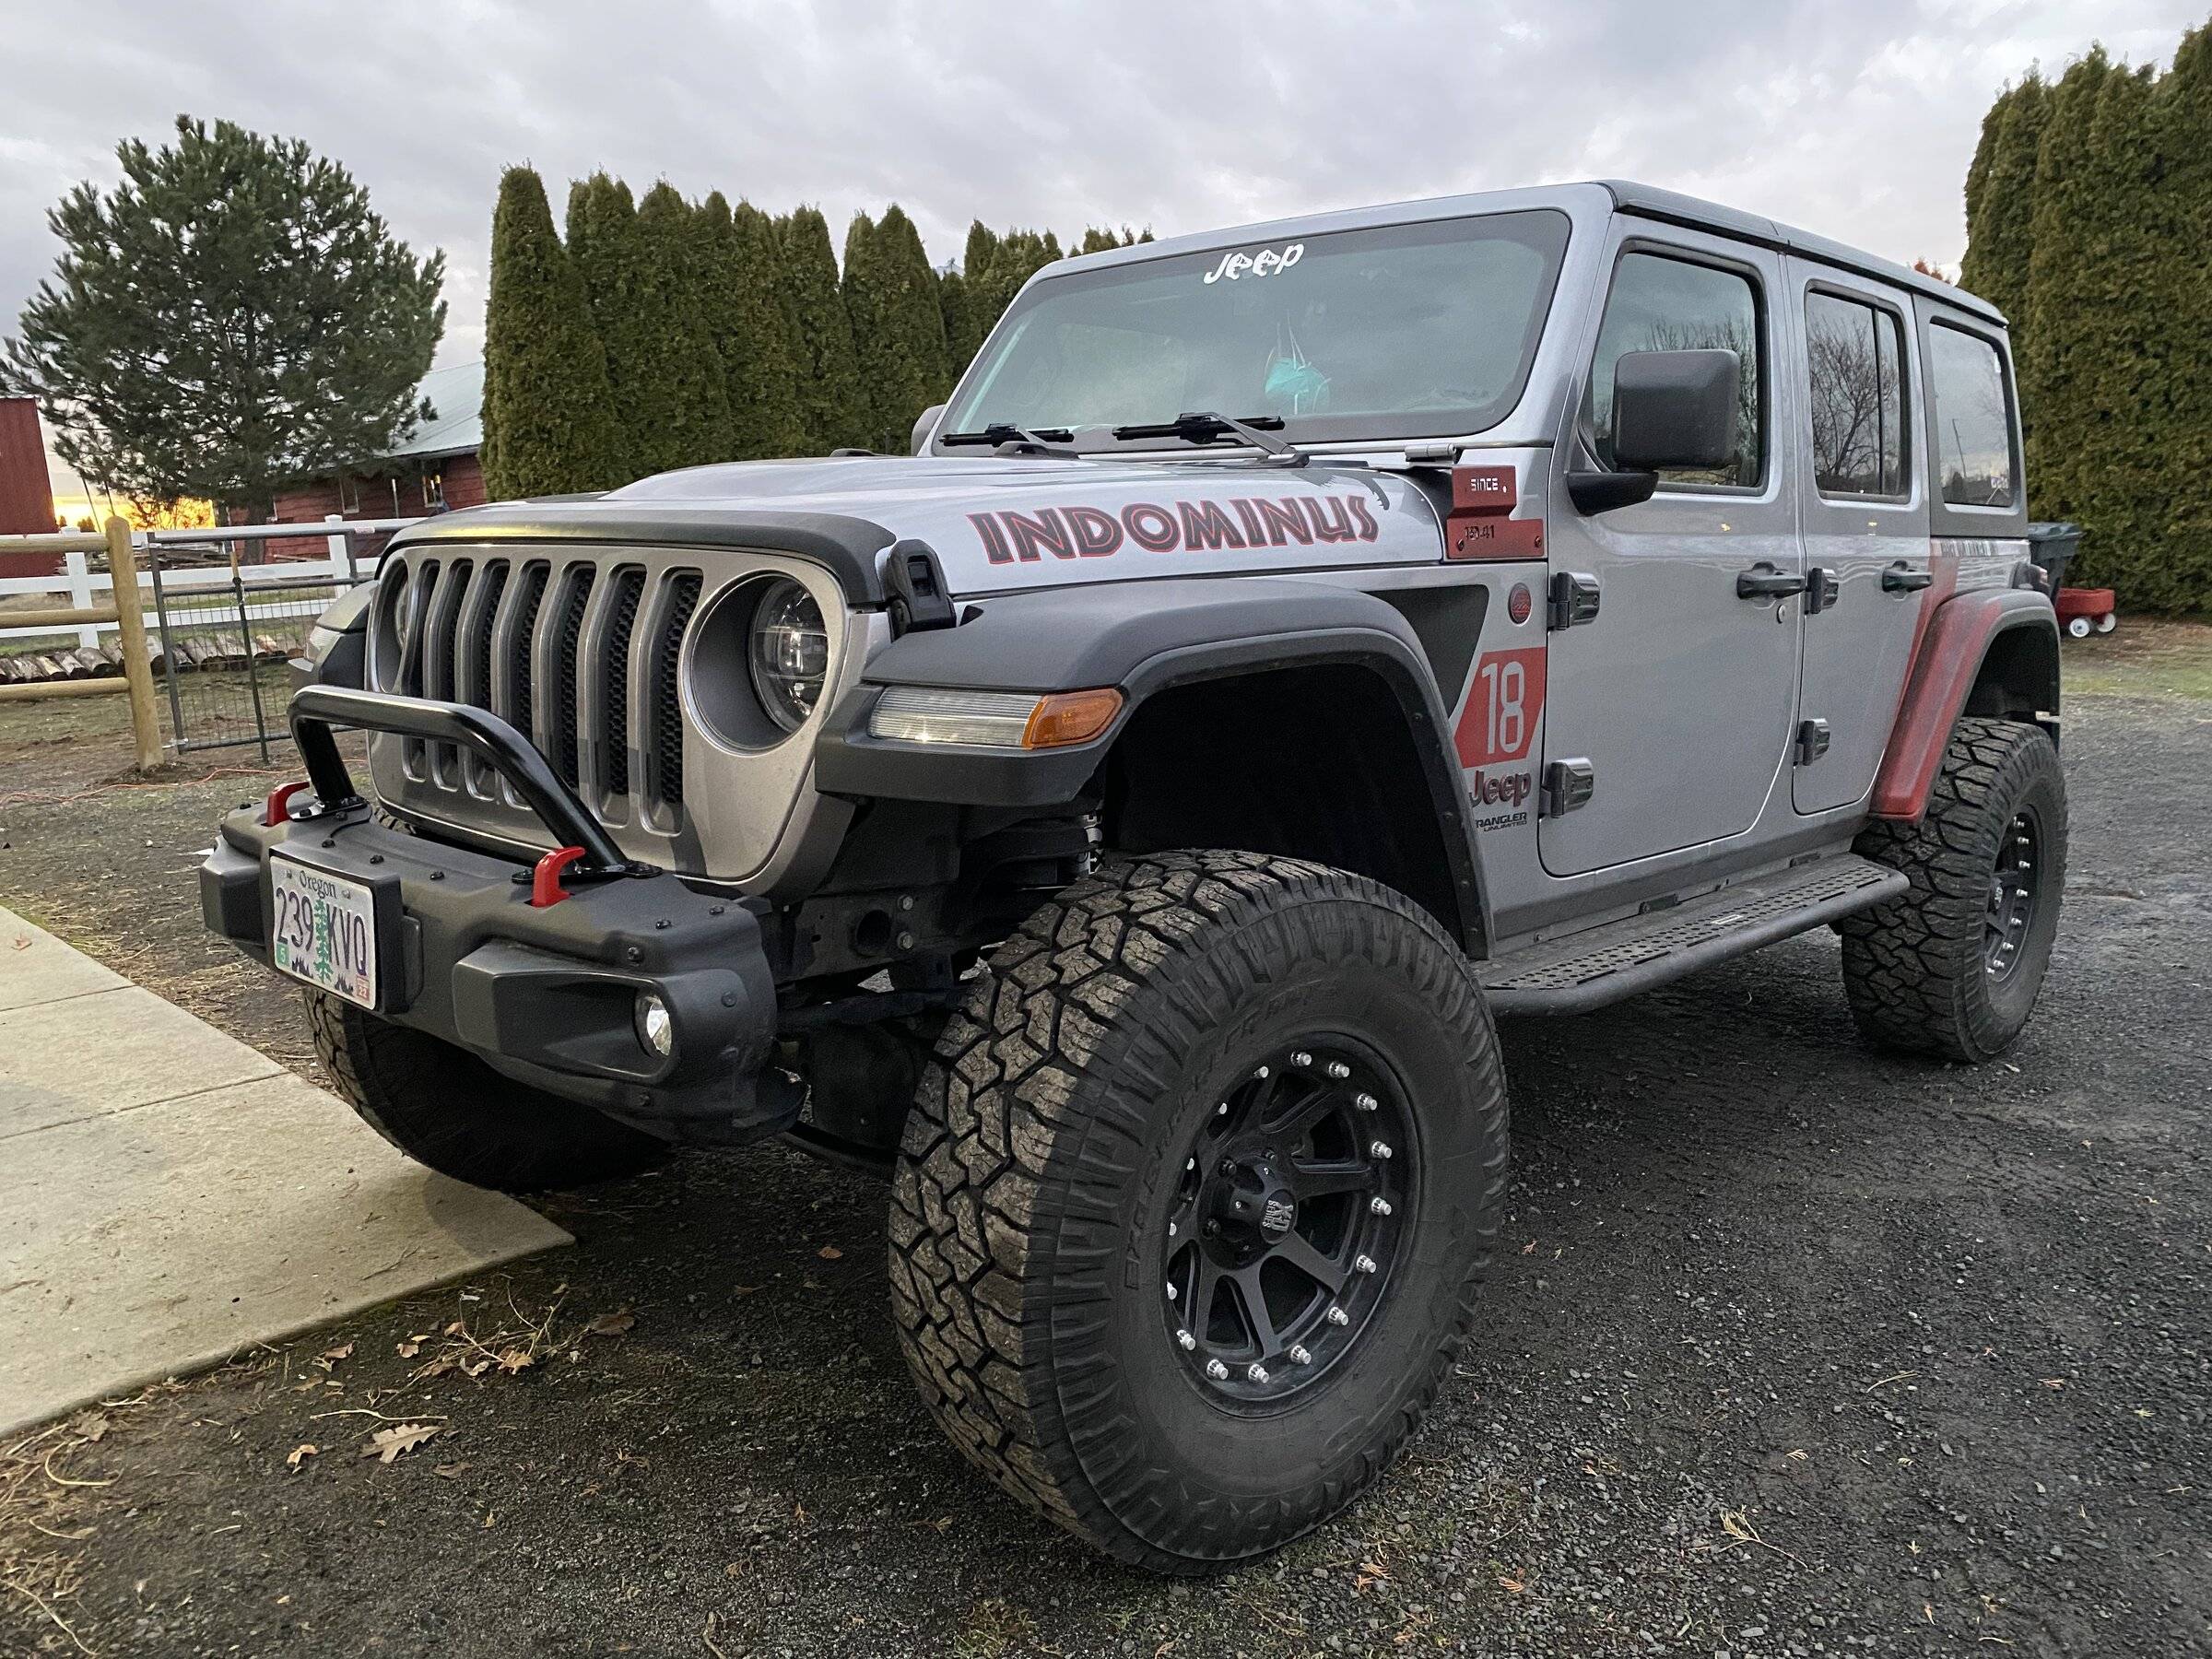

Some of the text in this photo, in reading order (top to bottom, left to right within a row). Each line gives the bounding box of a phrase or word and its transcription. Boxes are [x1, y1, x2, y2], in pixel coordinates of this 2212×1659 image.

[1203, 243, 1305, 285] Jeep
[1470, 477, 1499, 492] SINCE
[966, 494, 1380, 565] INDOMINUS
[1481, 661, 1525, 754] 18
[1468, 770, 1532, 807] Jeep
[1475, 812, 1527, 829] RANGLER
[300, 870, 337, 900] Oregon
[276, 887, 367, 977] 239 KVQ
